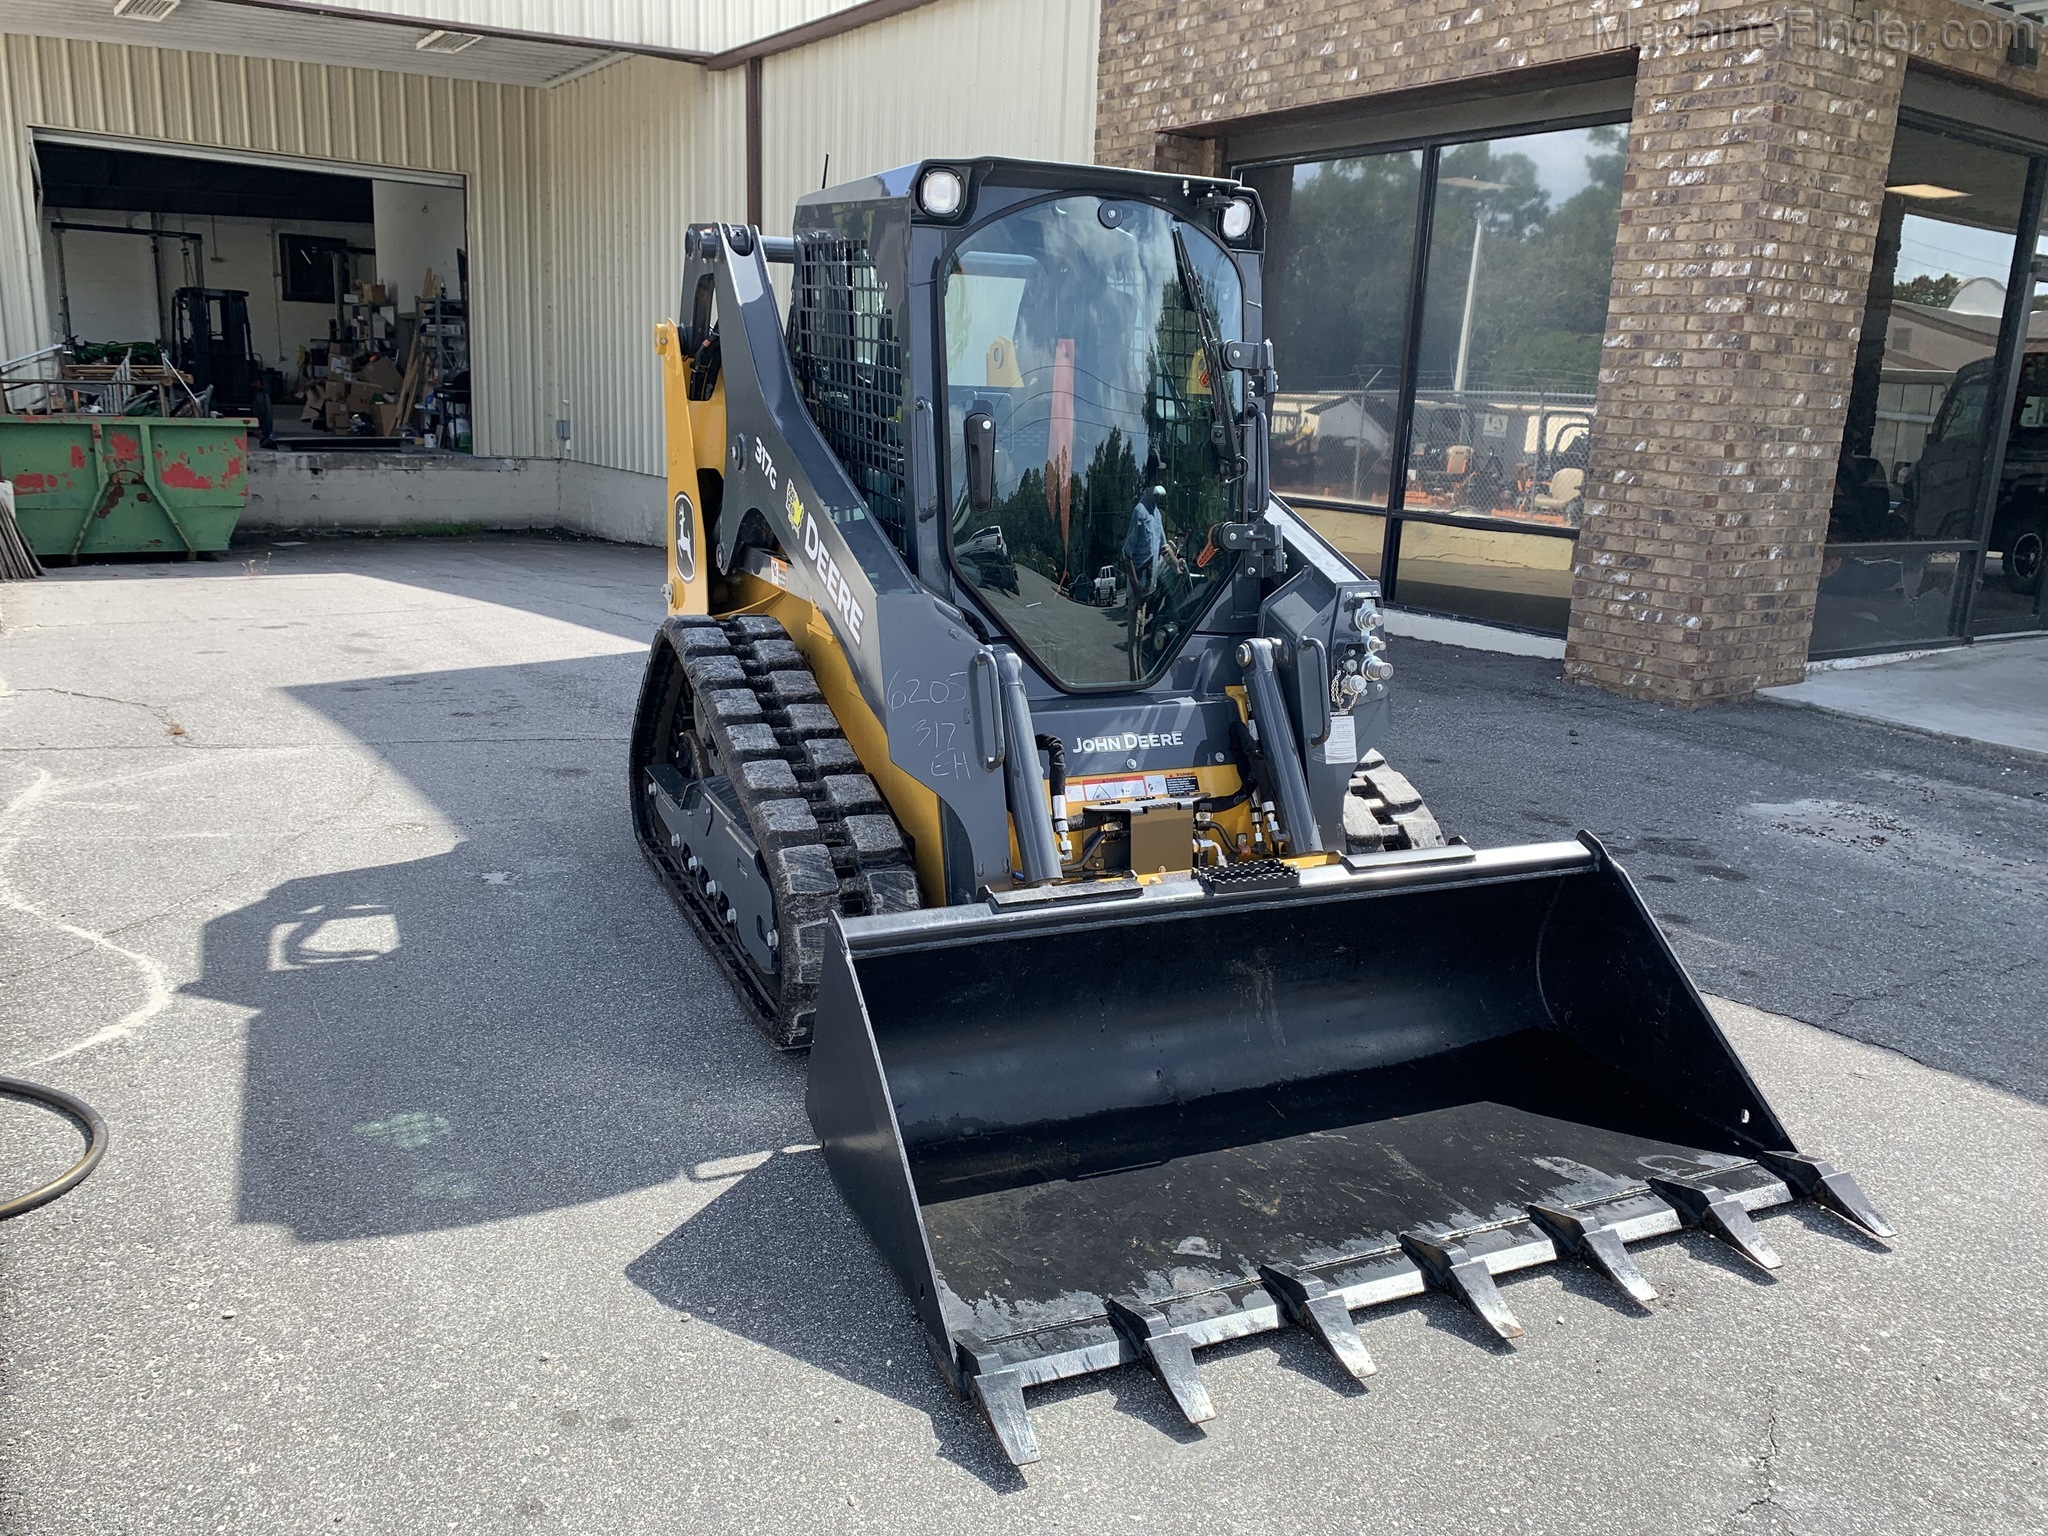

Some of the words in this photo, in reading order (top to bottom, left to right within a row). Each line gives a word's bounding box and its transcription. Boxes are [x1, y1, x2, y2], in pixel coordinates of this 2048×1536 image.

[754, 436, 778, 490] 317G
[805, 512, 864, 645] DEERE
[887, 670, 968, 712] 6205
[911, 719, 956, 751] 317
[1072, 737, 1121, 753] JOHN
[1123, 732, 1184, 749] DEERE
[930, 750, 971, 780] EH
